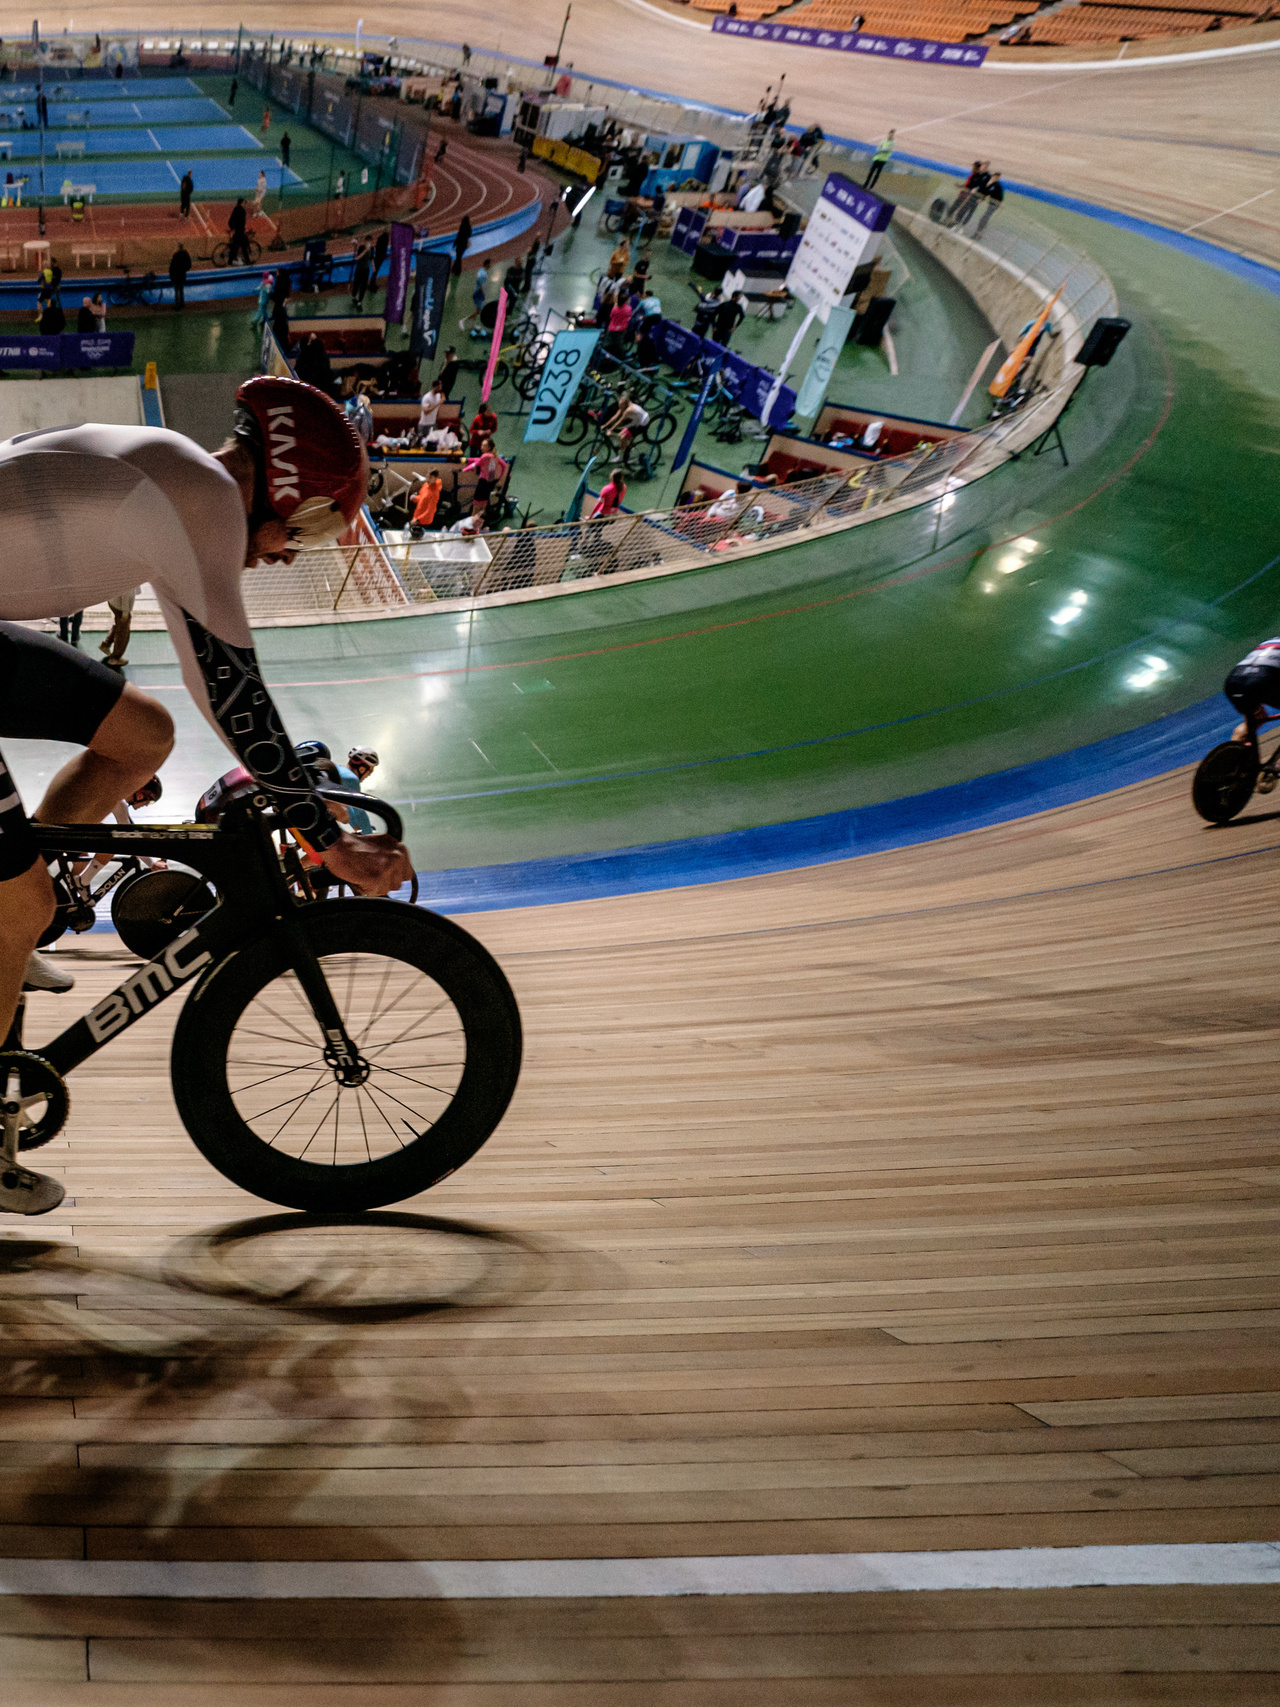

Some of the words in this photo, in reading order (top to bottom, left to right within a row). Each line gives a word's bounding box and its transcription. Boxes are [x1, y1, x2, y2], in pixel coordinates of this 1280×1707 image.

[532, 349, 581, 425] U238
[266, 405, 300, 502] KASK
[94, 868, 126, 898] DOLAN
[83, 927, 213, 1043] BMC
[326, 1028, 355, 1067] BMC
